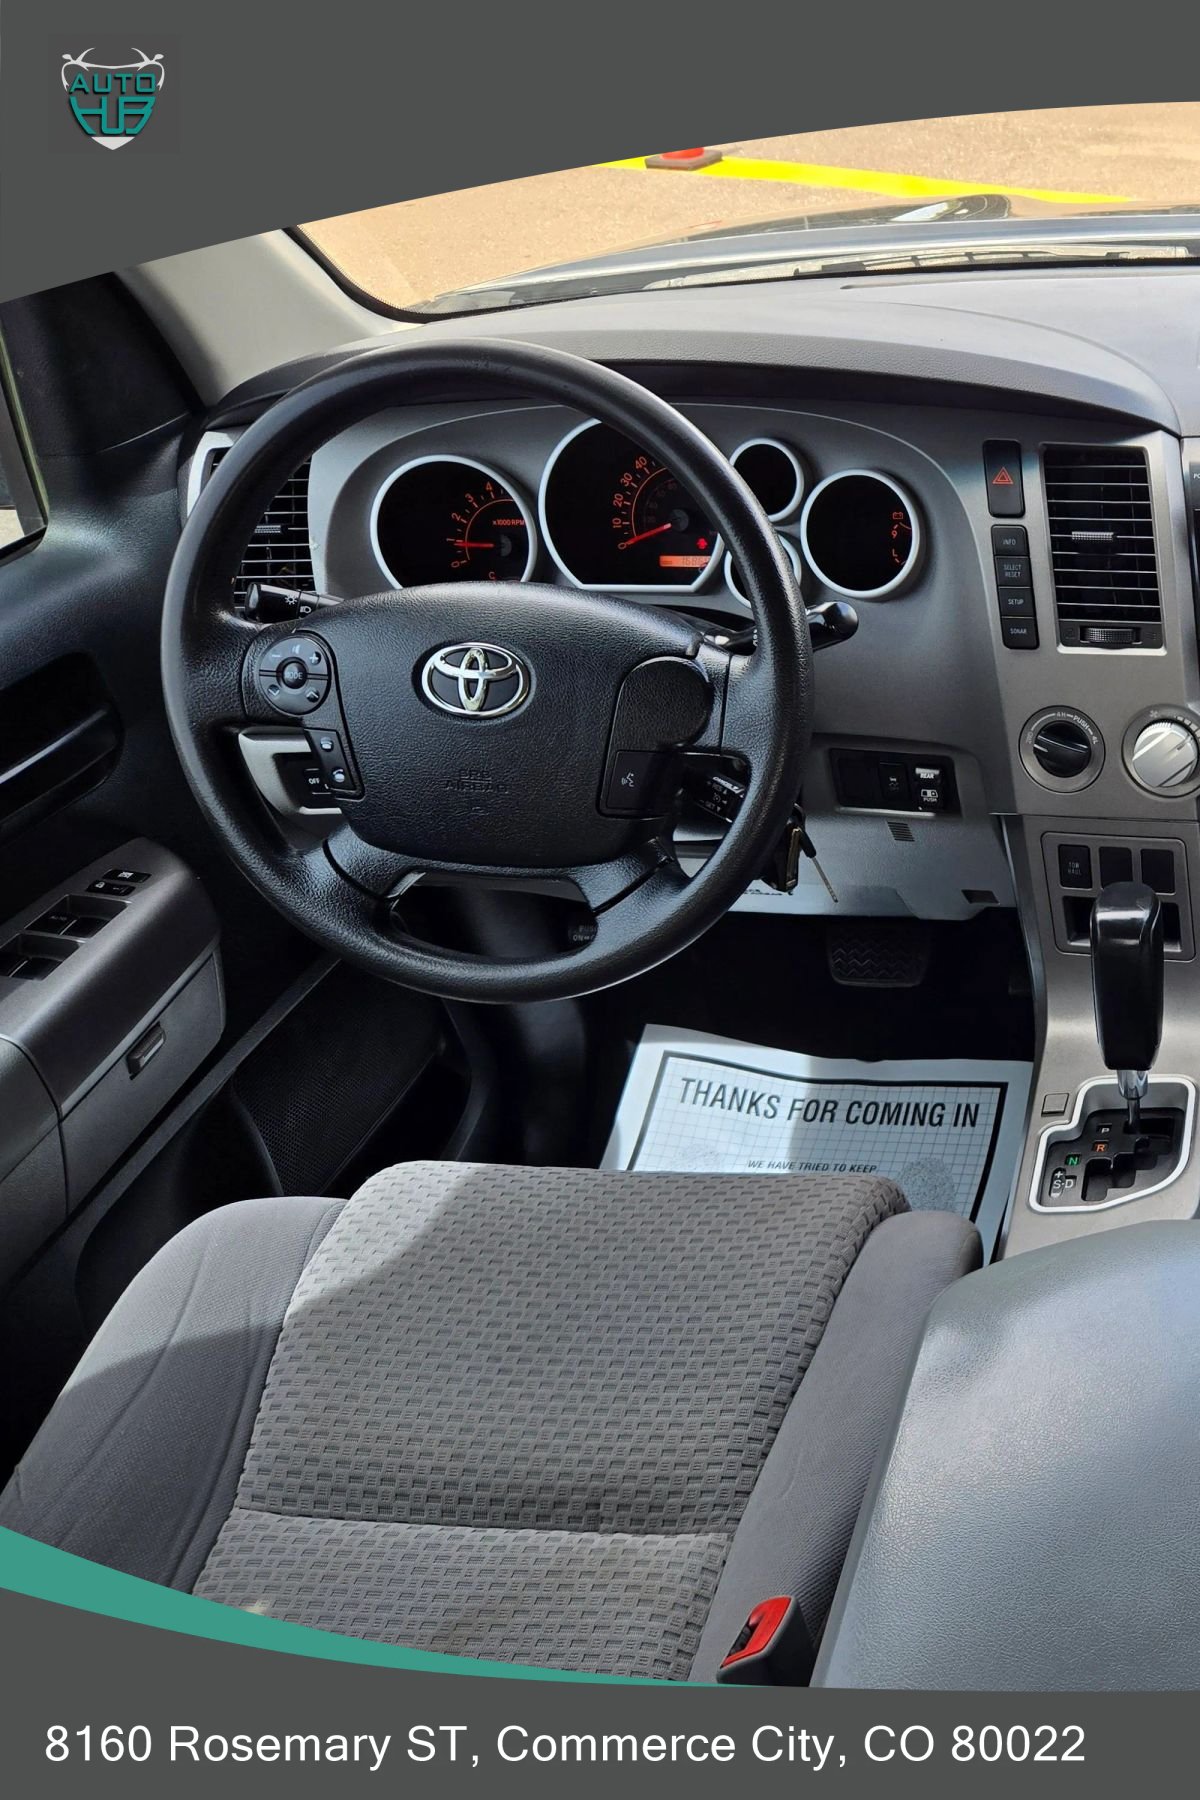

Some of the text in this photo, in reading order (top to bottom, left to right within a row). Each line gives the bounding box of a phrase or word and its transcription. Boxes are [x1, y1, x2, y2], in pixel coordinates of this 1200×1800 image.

[635, 456, 647, 470] 40
[620, 472, 633, 487] 30
[612, 493, 624, 508] 20
[612, 517, 622, 529] 10
[1003, 563, 1022, 571] SELECT
[1009, 627, 1027, 635] SONAR
[679, 1077, 981, 1128] THANKS FOR COMING IN
[1096, 1144, 1106, 1152] R
[748, 1160, 878, 1174] WE HAVE TRIED TO KEEP
[1068, 1156, 1079, 1166] N
